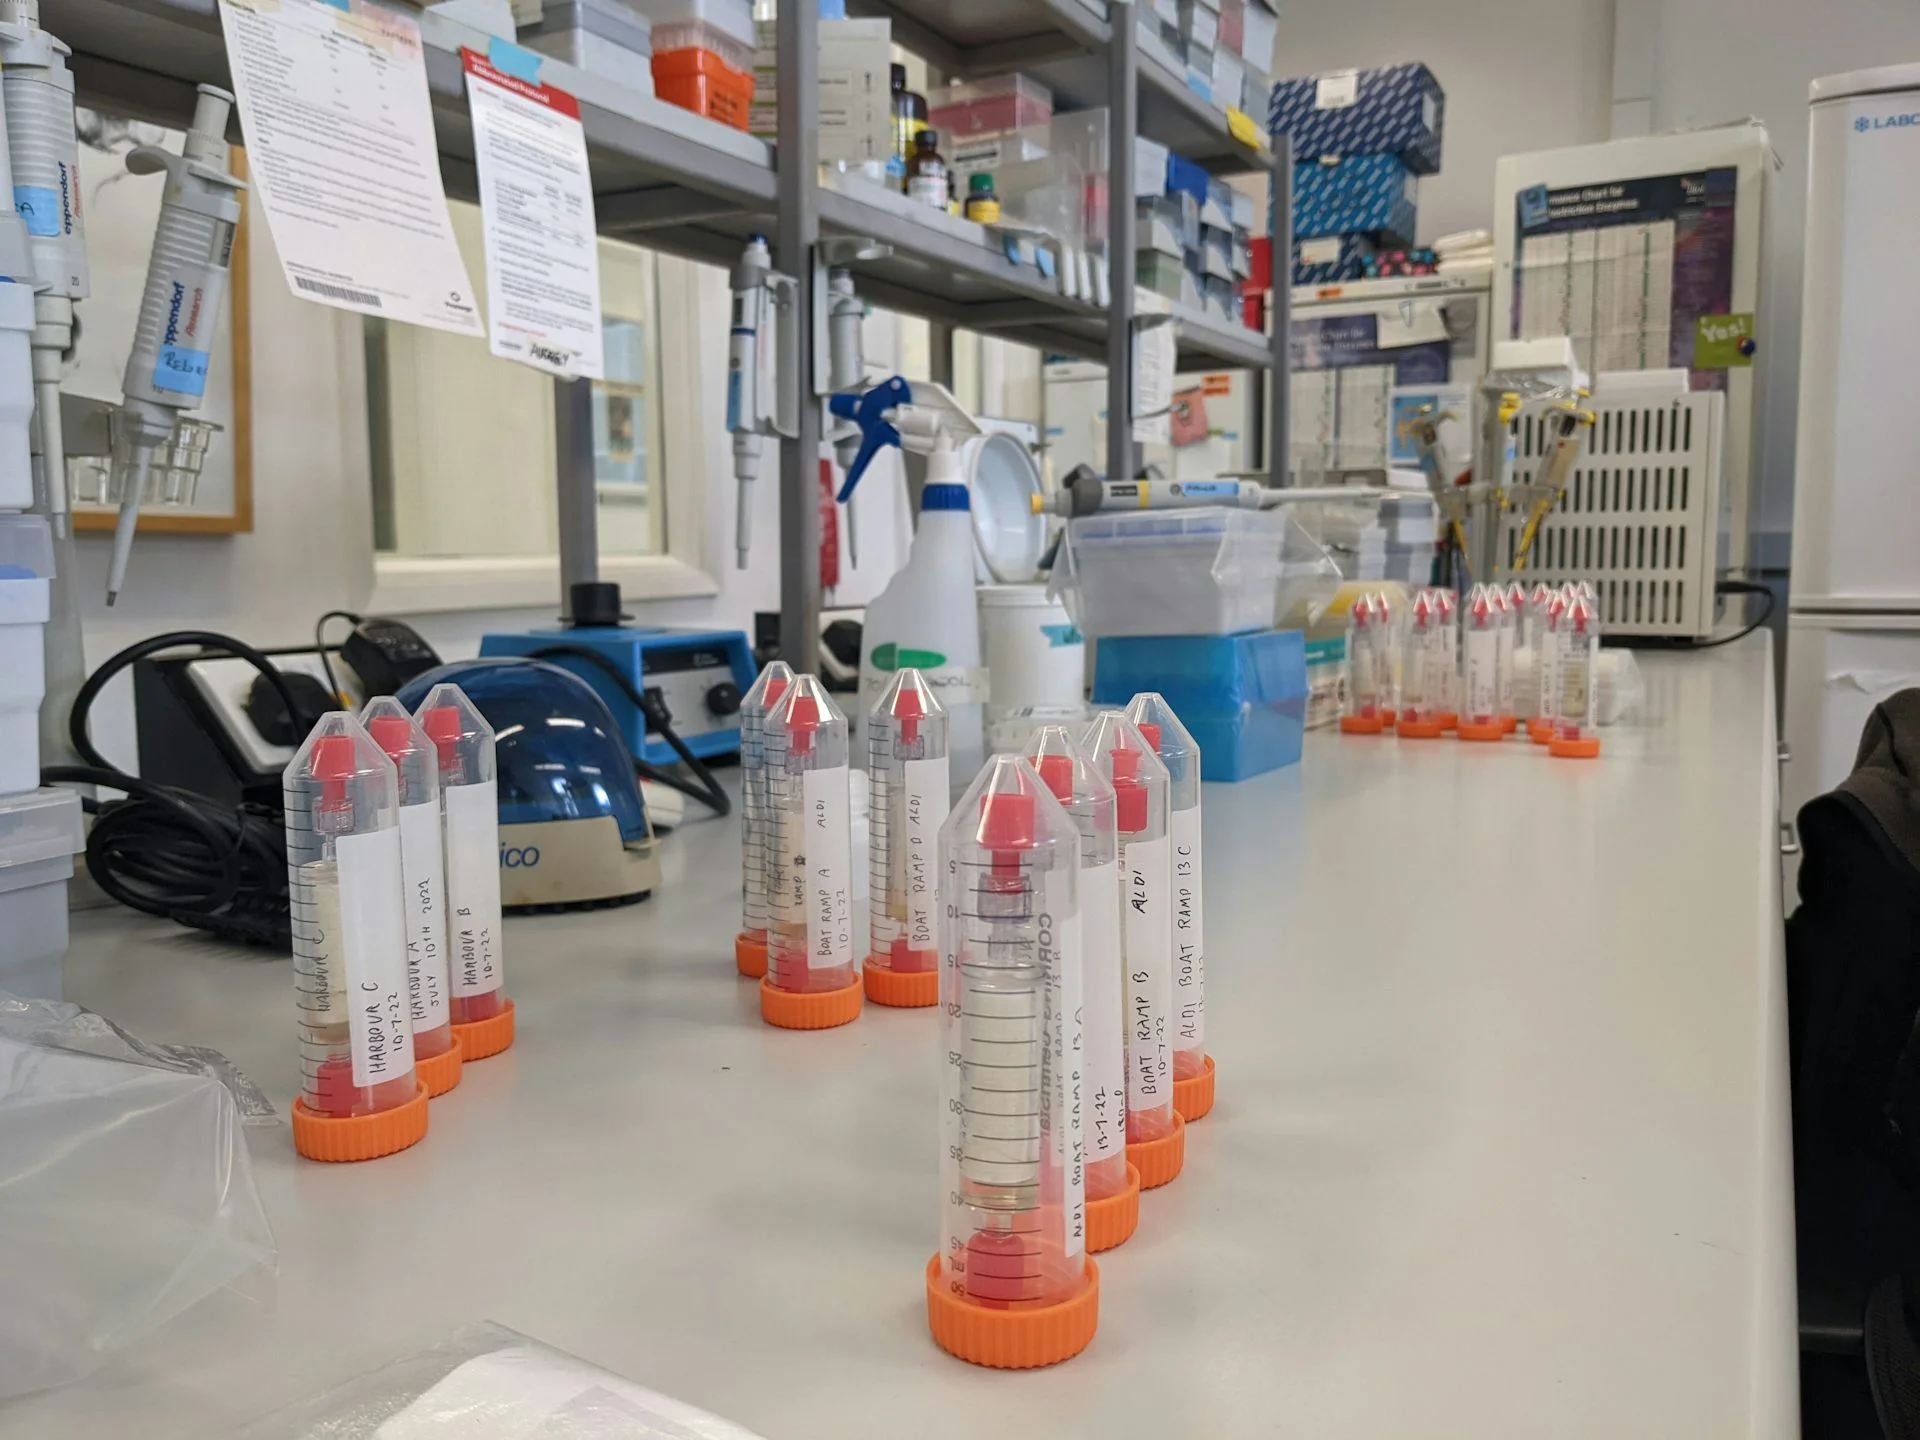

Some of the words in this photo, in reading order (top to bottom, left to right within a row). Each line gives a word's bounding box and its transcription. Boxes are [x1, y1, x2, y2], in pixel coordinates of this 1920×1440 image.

[58, 160, 72, 236] eppendorf
[1703, 317, 1747, 344] Yes!
[816, 799, 827, 829] ALDI
[908, 793, 922, 826] ALDI
[818, 867, 831, 878] A
[911, 852, 928, 895] RAMP
[1132, 869, 1148, 914] ALDI
[418, 877, 433, 914] 2022
[456, 906, 472, 917] B
[818, 888, 833, 926] RAMP
[1177, 887, 1193, 930] RAMP
[817, 926, 833, 957] BOAT
[911, 909, 931, 944] BOAT
[462, 929, 478, 987] HARBOUR
[1132, 970, 1149, 983] B
[1178, 943, 1194, 988] BOAT
[361, 981, 379, 992] C
[426, 975, 440, 1007] JULY
[1136, 995, 1151, 1041] RAMP
[1181, 1001, 1197, 1039] ALDI
[364, 1002, 387, 1075] HARBOUR
[1141, 1055, 1157, 1095] BOAT
[1071, 1069, 1082, 1130] RAMP
[1094, 1086, 1109, 1151] 13-7-22
[1071, 1140, 1083, 1187] BOAT
